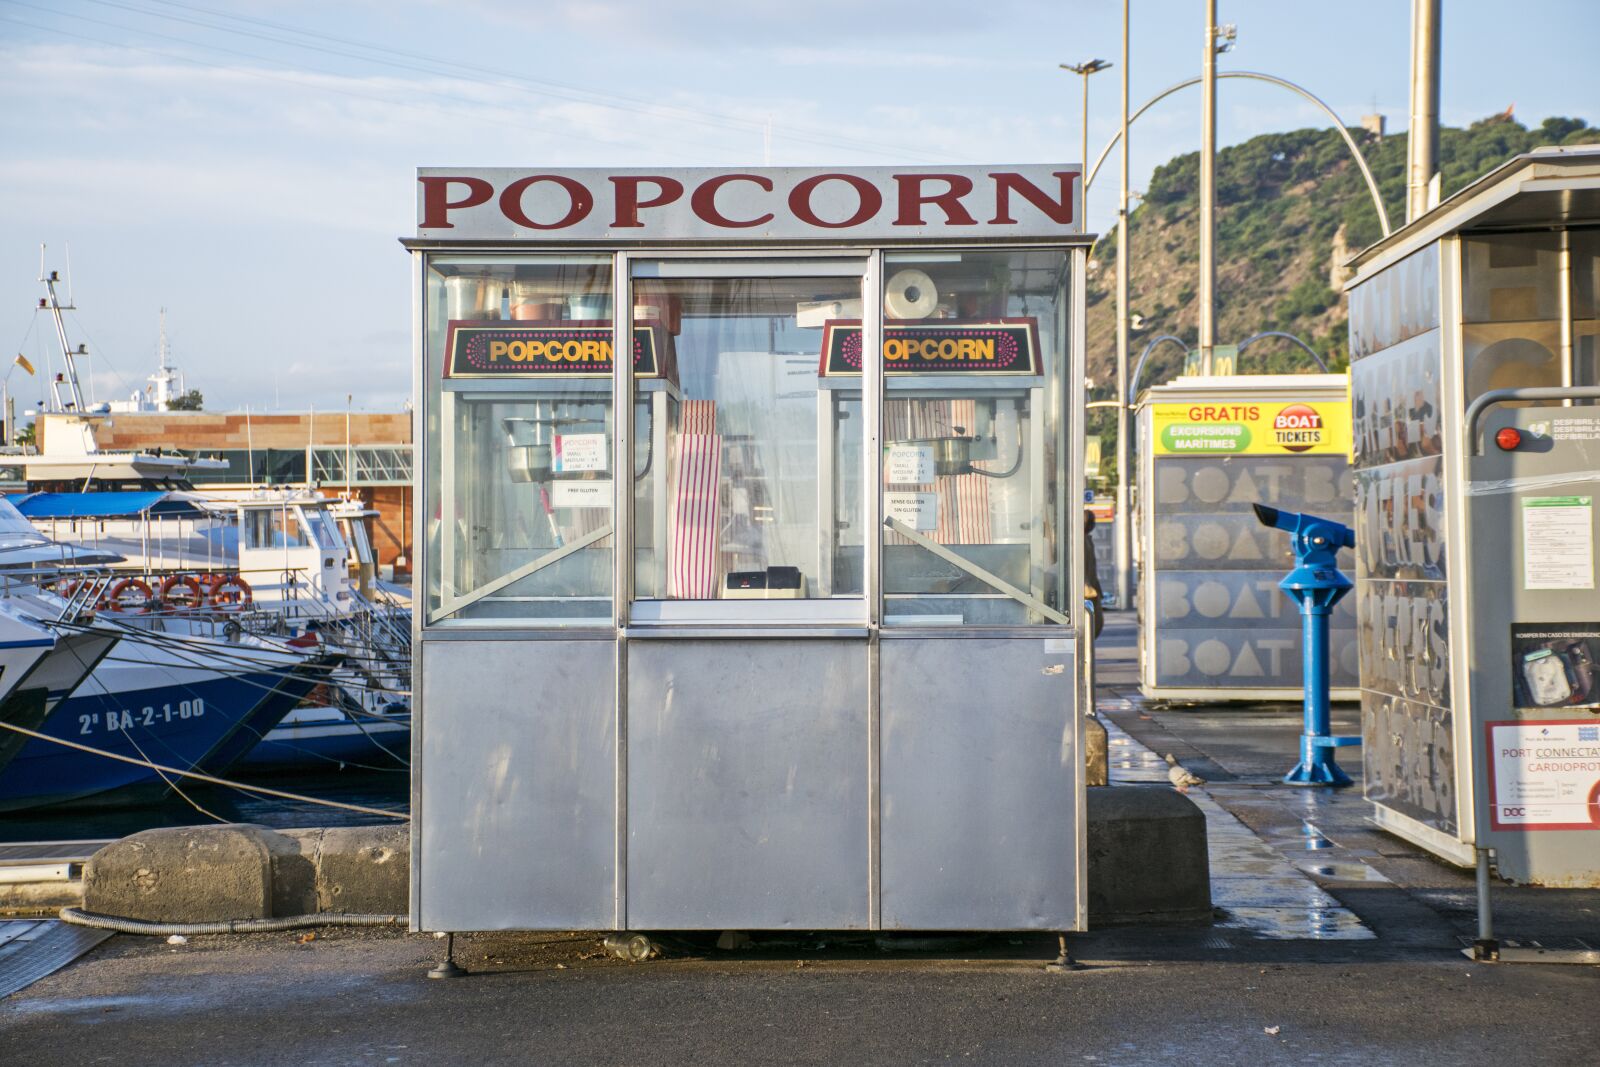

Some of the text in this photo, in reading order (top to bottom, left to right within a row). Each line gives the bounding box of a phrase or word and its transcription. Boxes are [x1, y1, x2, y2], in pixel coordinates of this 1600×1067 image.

[418, 172, 1081, 230] POPCORN
[884, 339, 994, 360] OPCORN
[1189, 406, 1260, 421] GRATIS
[1276, 415, 1321, 428] BOAT
[1169, 426, 1242, 436] EXCURSIONS
[1276, 431, 1321, 443] TICKETS
[1159, 466, 1293, 503] BOAT
[1160, 581, 1282, 618] BOAT
[1160, 639, 1294, 677] BOAT
[79, 698, 205, 735] 2ª BA-2-1-00
[1502, 748, 1531, 758] PORT
[1503, 807, 1526, 817] DOC
